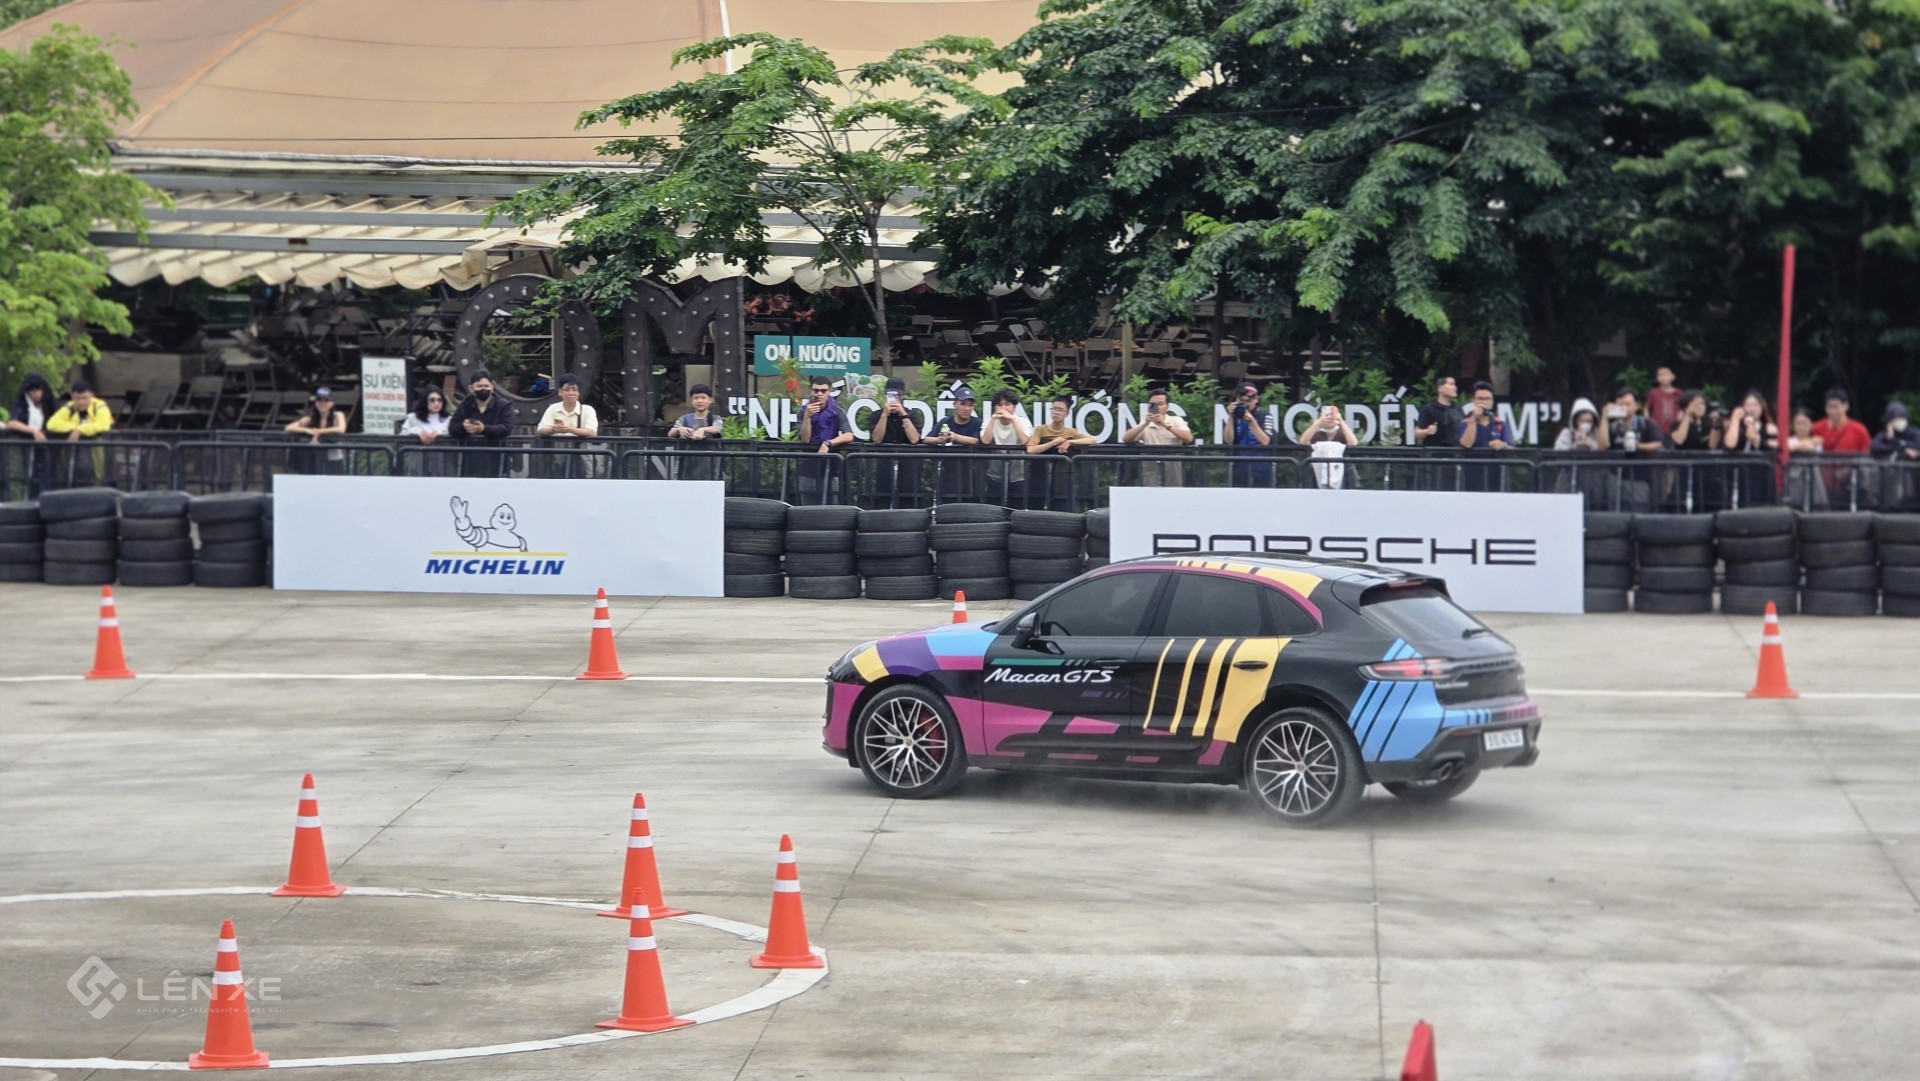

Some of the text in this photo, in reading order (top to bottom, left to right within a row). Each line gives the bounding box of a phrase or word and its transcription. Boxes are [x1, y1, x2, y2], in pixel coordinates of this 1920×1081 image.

[799, 342, 861, 363] NƯỚNG
[1152, 533, 1537, 566] PORSCHE
[424, 558, 566, 576] MICHELIN
[1063, 670, 1114, 683] GTS
